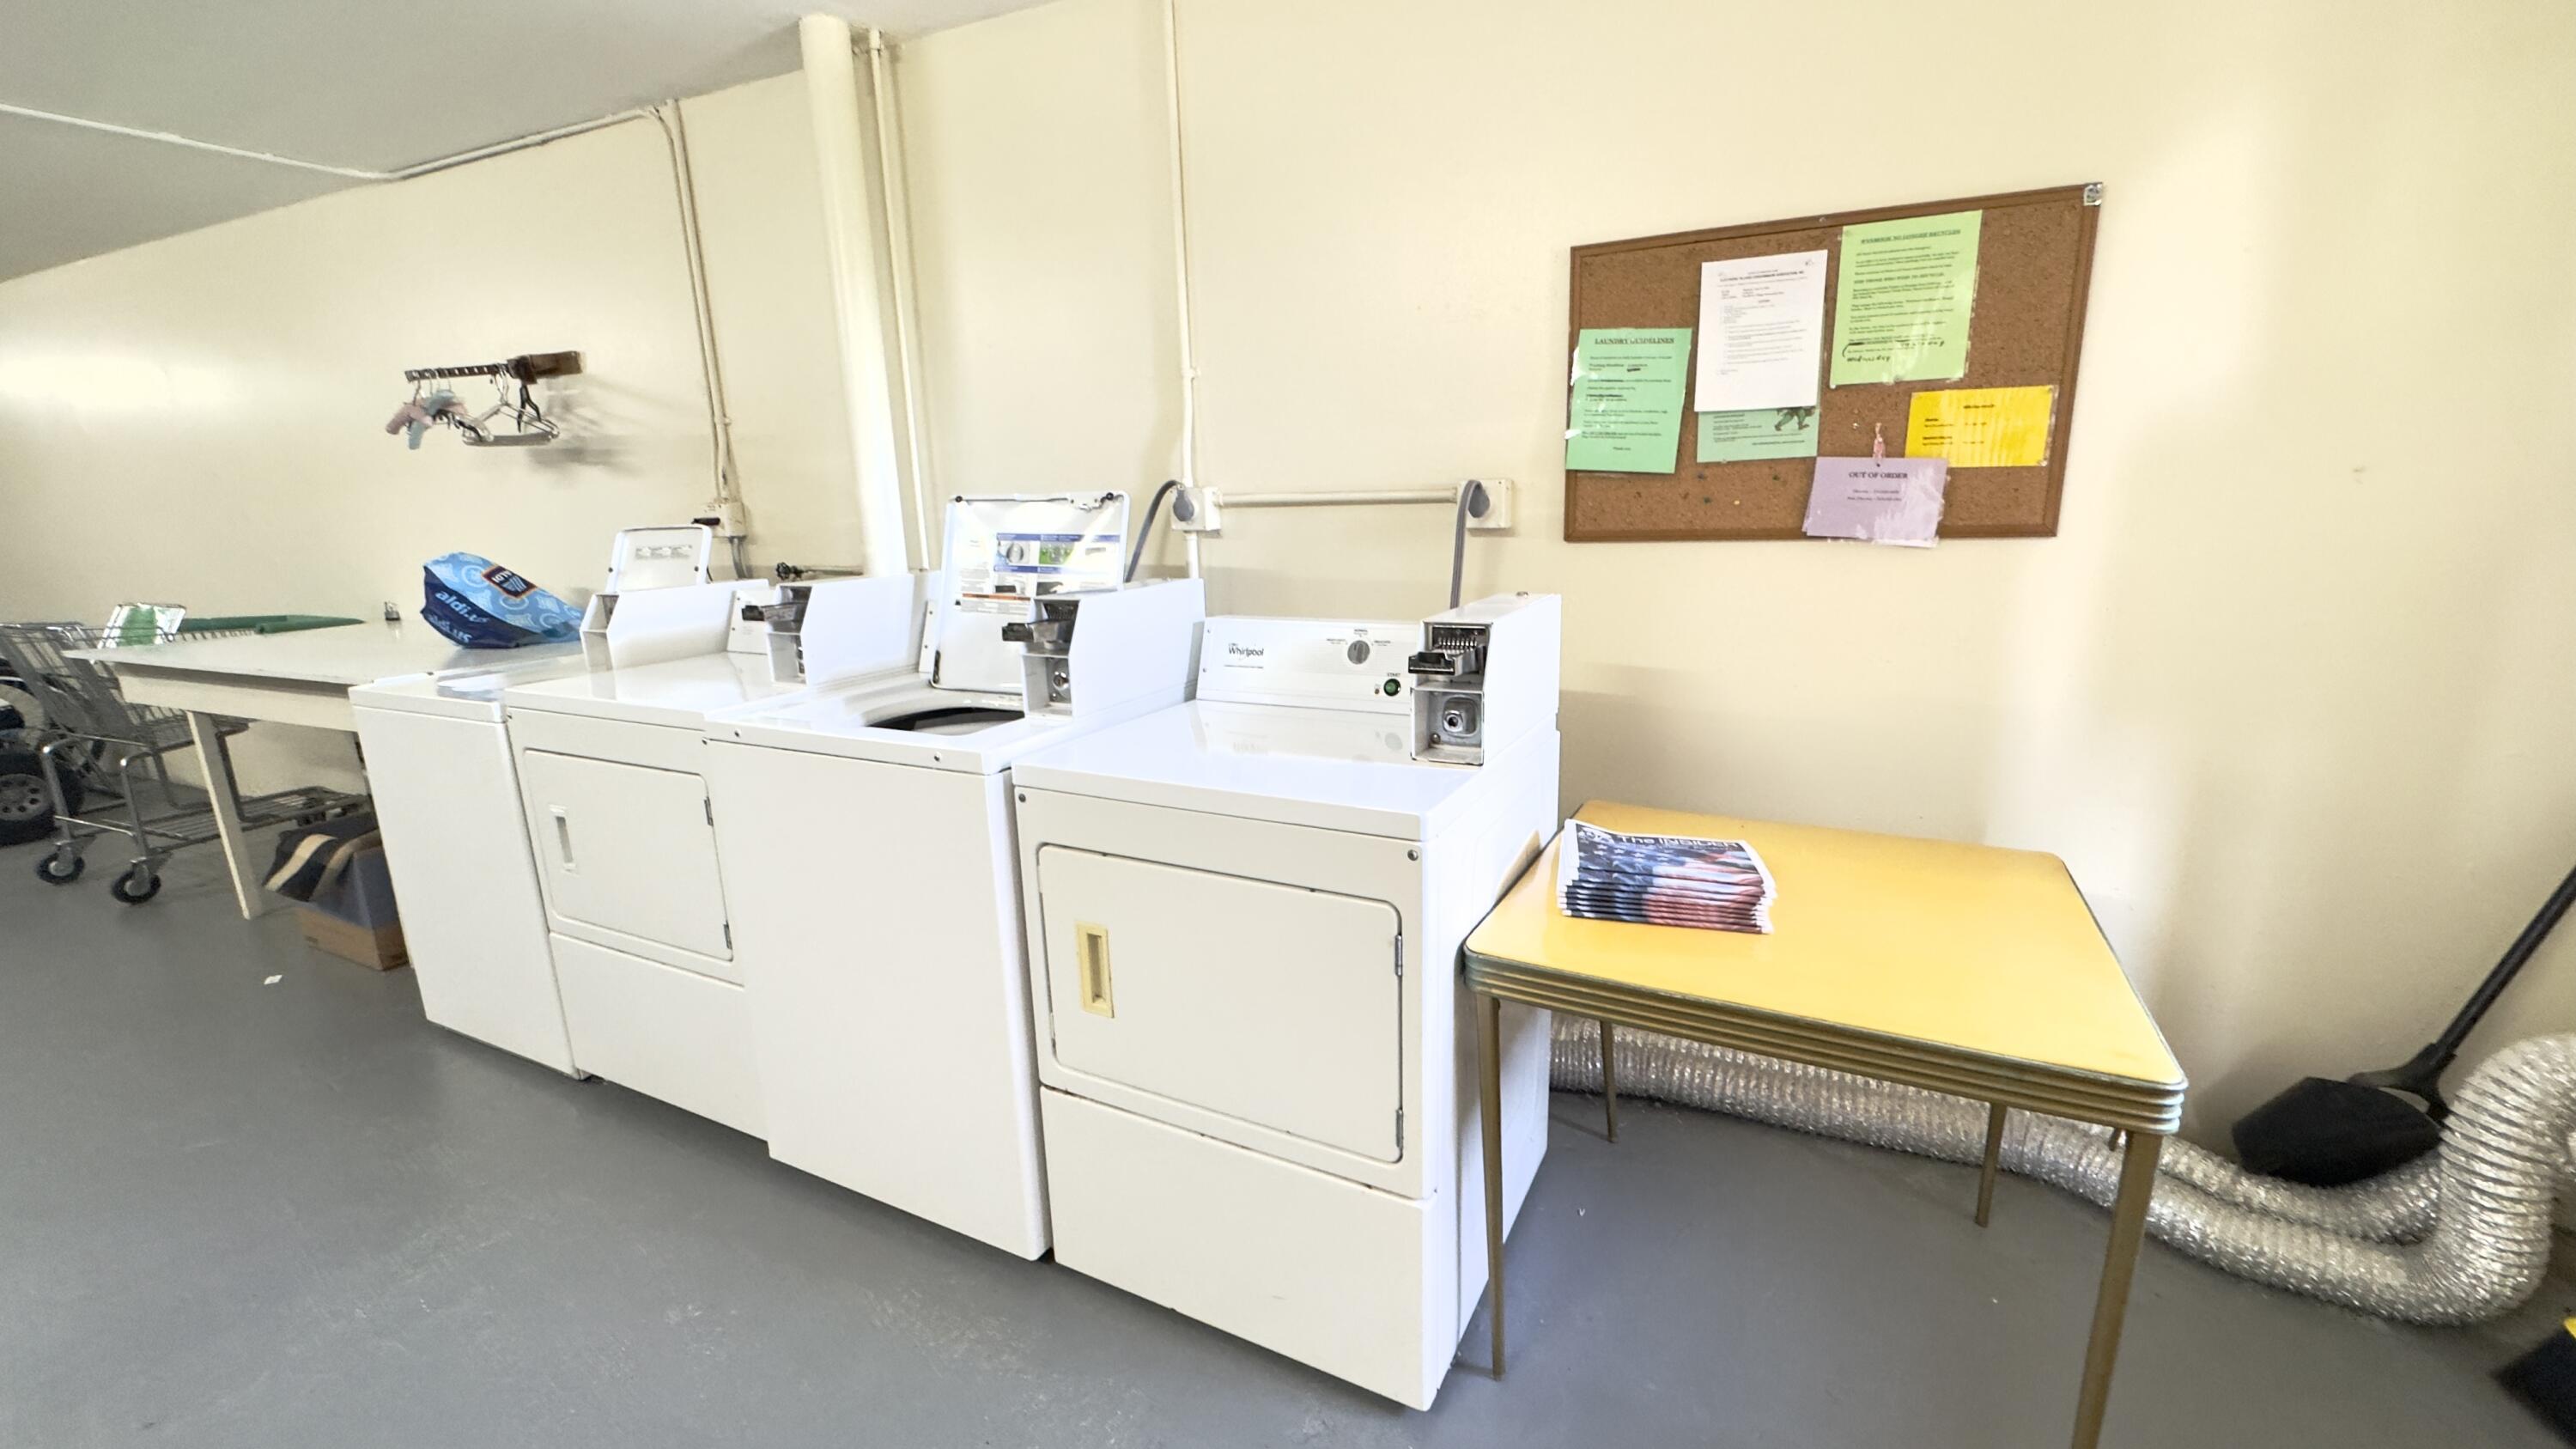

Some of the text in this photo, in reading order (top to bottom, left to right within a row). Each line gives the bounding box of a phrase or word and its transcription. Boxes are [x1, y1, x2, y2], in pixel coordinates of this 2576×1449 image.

[491, 570, 513, 584] ALDI
[1228, 646, 1264, 658] Whirlpool
[1658, 837, 1739, 848] INSIDER
